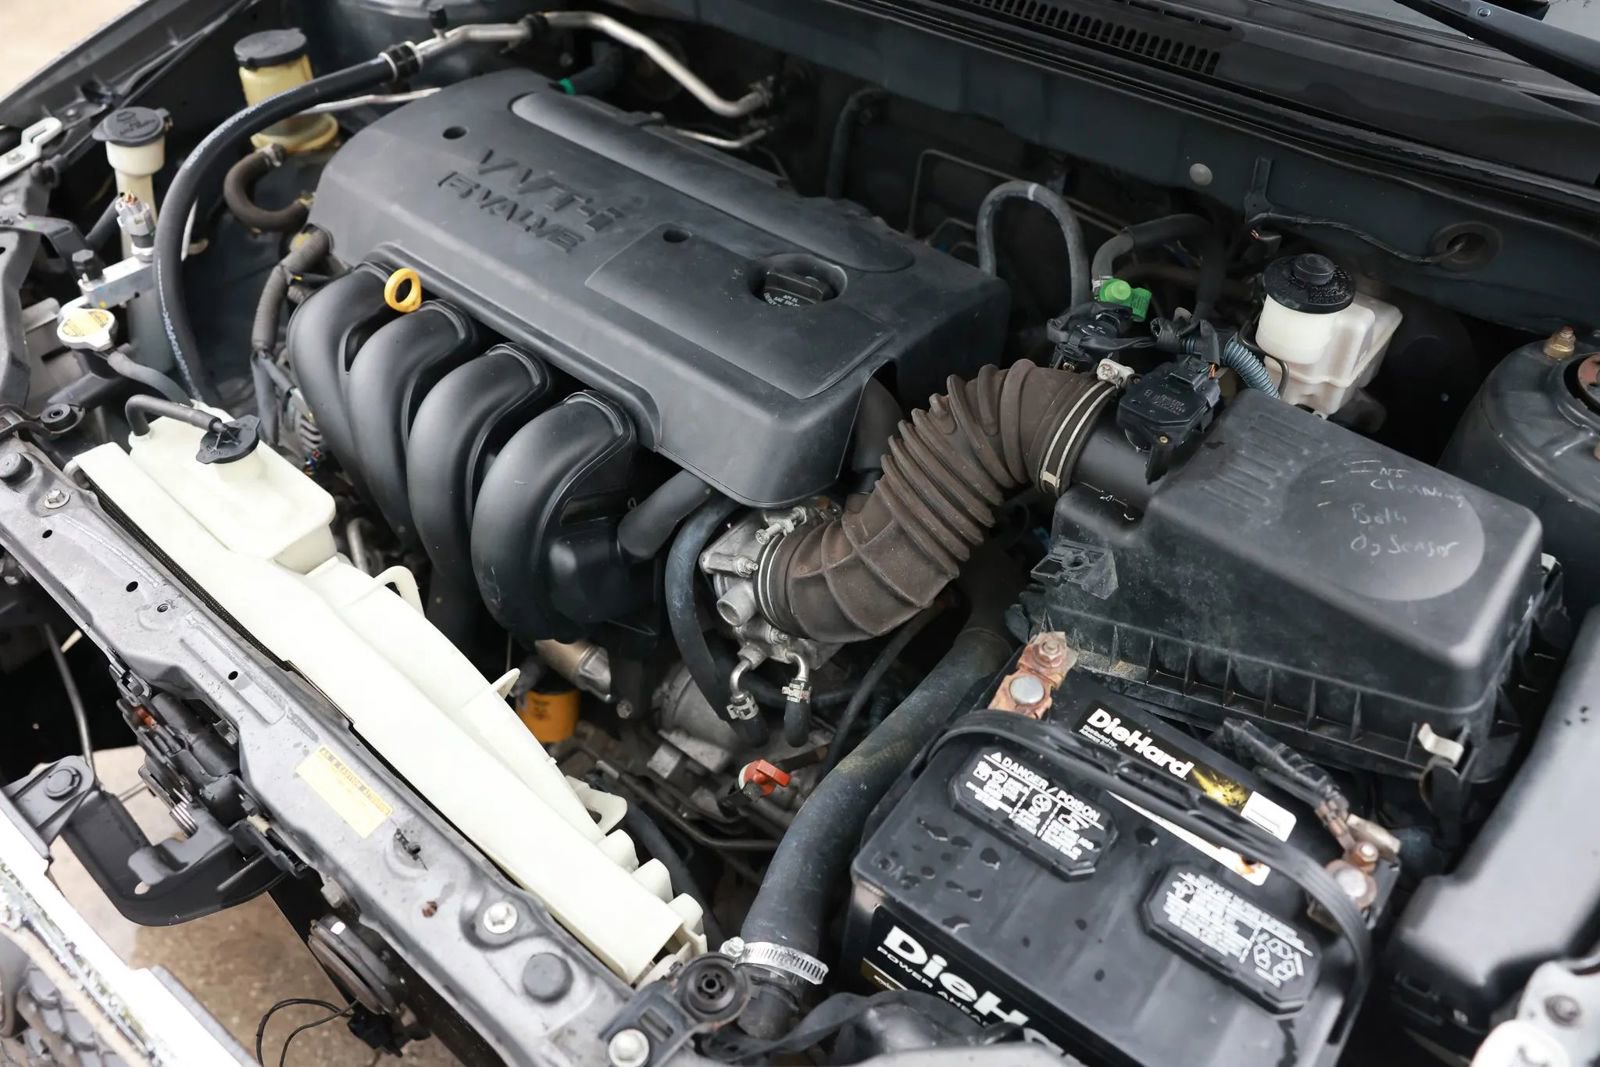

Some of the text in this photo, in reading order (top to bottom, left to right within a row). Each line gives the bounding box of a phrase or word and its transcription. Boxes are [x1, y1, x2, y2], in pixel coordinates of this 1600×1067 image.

[1086, 707, 1195, 780] DieHard
[1000, 756, 1050, 793] DANGER
[1056, 789, 1102, 822] POISON
[876, 946, 989, 1028] POWER AHEA
[882, 924, 1088, 1067] DieH
